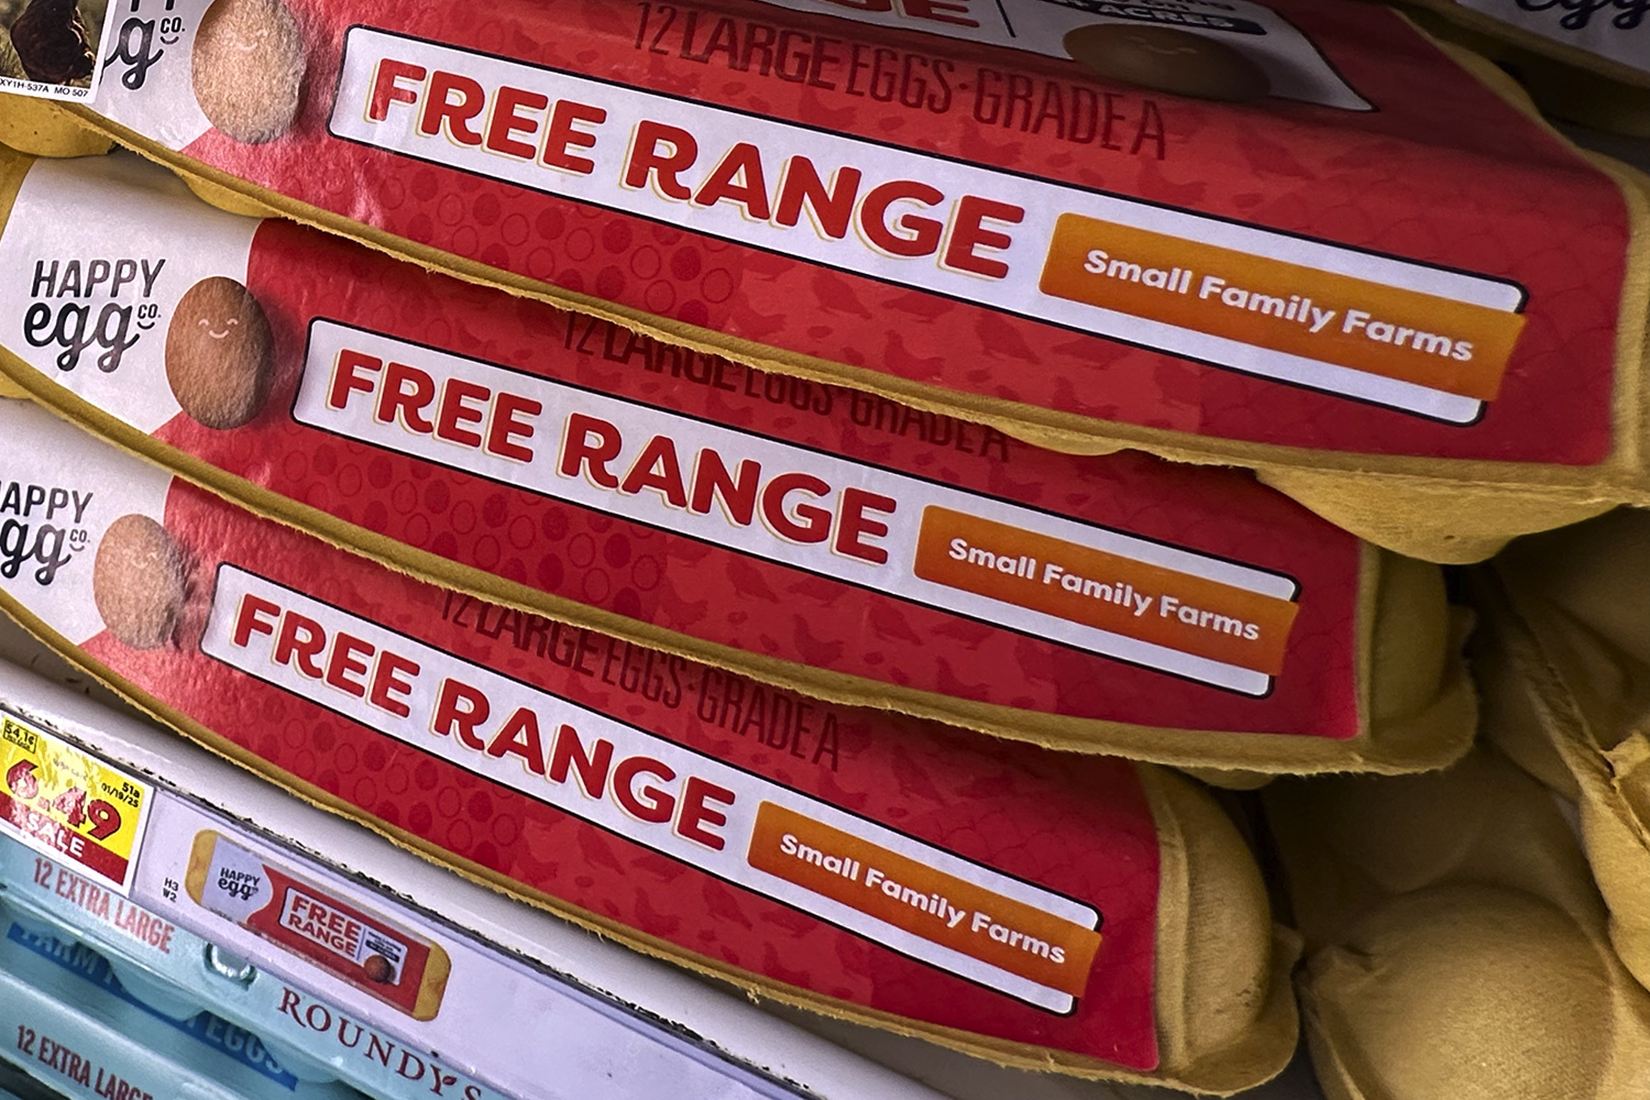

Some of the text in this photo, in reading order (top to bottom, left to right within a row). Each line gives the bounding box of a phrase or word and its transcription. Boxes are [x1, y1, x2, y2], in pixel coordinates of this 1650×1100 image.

[633, 1, 672, 53] 12
[677, 7, 843, 95] LARGE
[1129, 100, 1168, 162] A
[364, 56, 1474, 363] FREE RANGE Small Family Farms
[31, 259, 167, 299] HAPPY
[325, 347, 1261, 643] FREE RANGE Small Family Farms
[230, 592, 1067, 966] FREE RANGE Small Family Farms
[27, 811, 86, 858] SALE
[34, 857, 176, 955] 12 EXTRA LARGE
[164, 877, 179, 892] H3
[220, 867, 261, 889] HAPPY
[17, 1025, 92, 1088] 12 EXTRA
